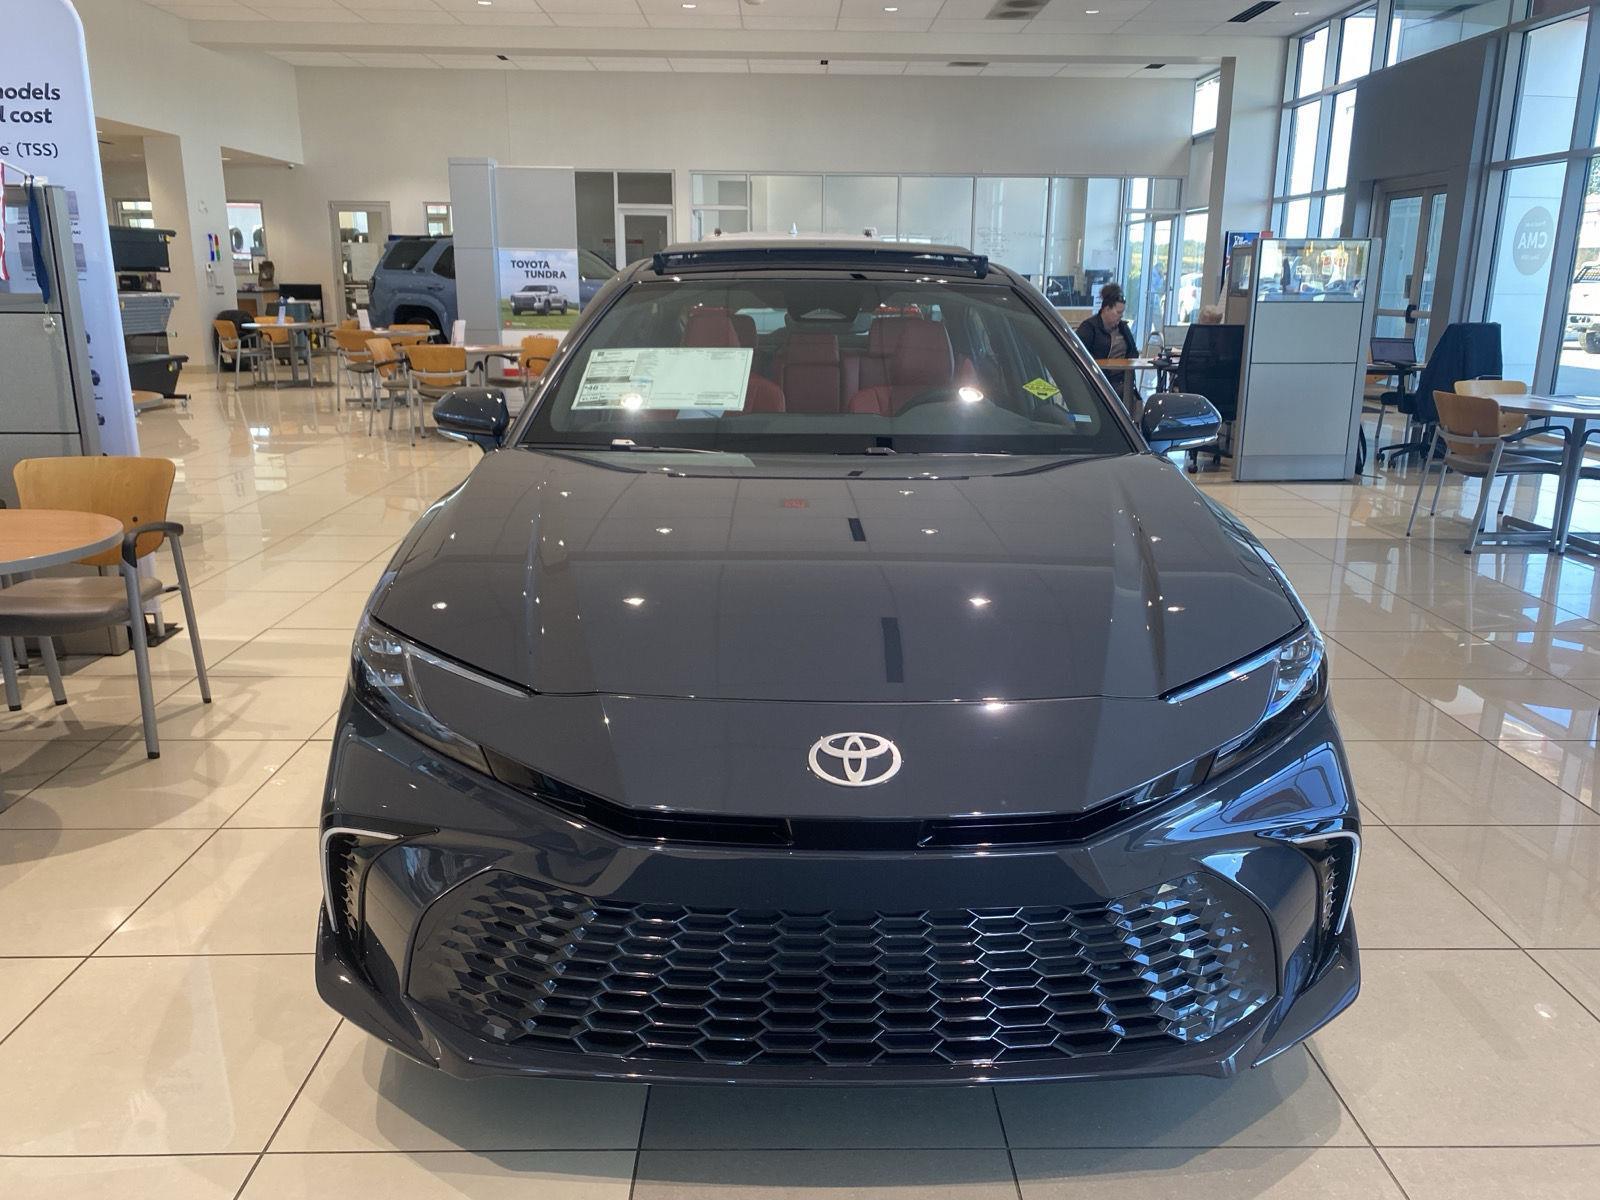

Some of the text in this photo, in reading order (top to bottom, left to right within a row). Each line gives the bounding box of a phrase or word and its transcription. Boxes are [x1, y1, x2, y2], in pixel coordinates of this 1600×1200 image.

[9, 108, 53, 124] cost
[16, 141, 59, 159] (TSS)
[510, 259, 550, 269] TOYOTA
[524, 270, 567, 280] TUNDRA
